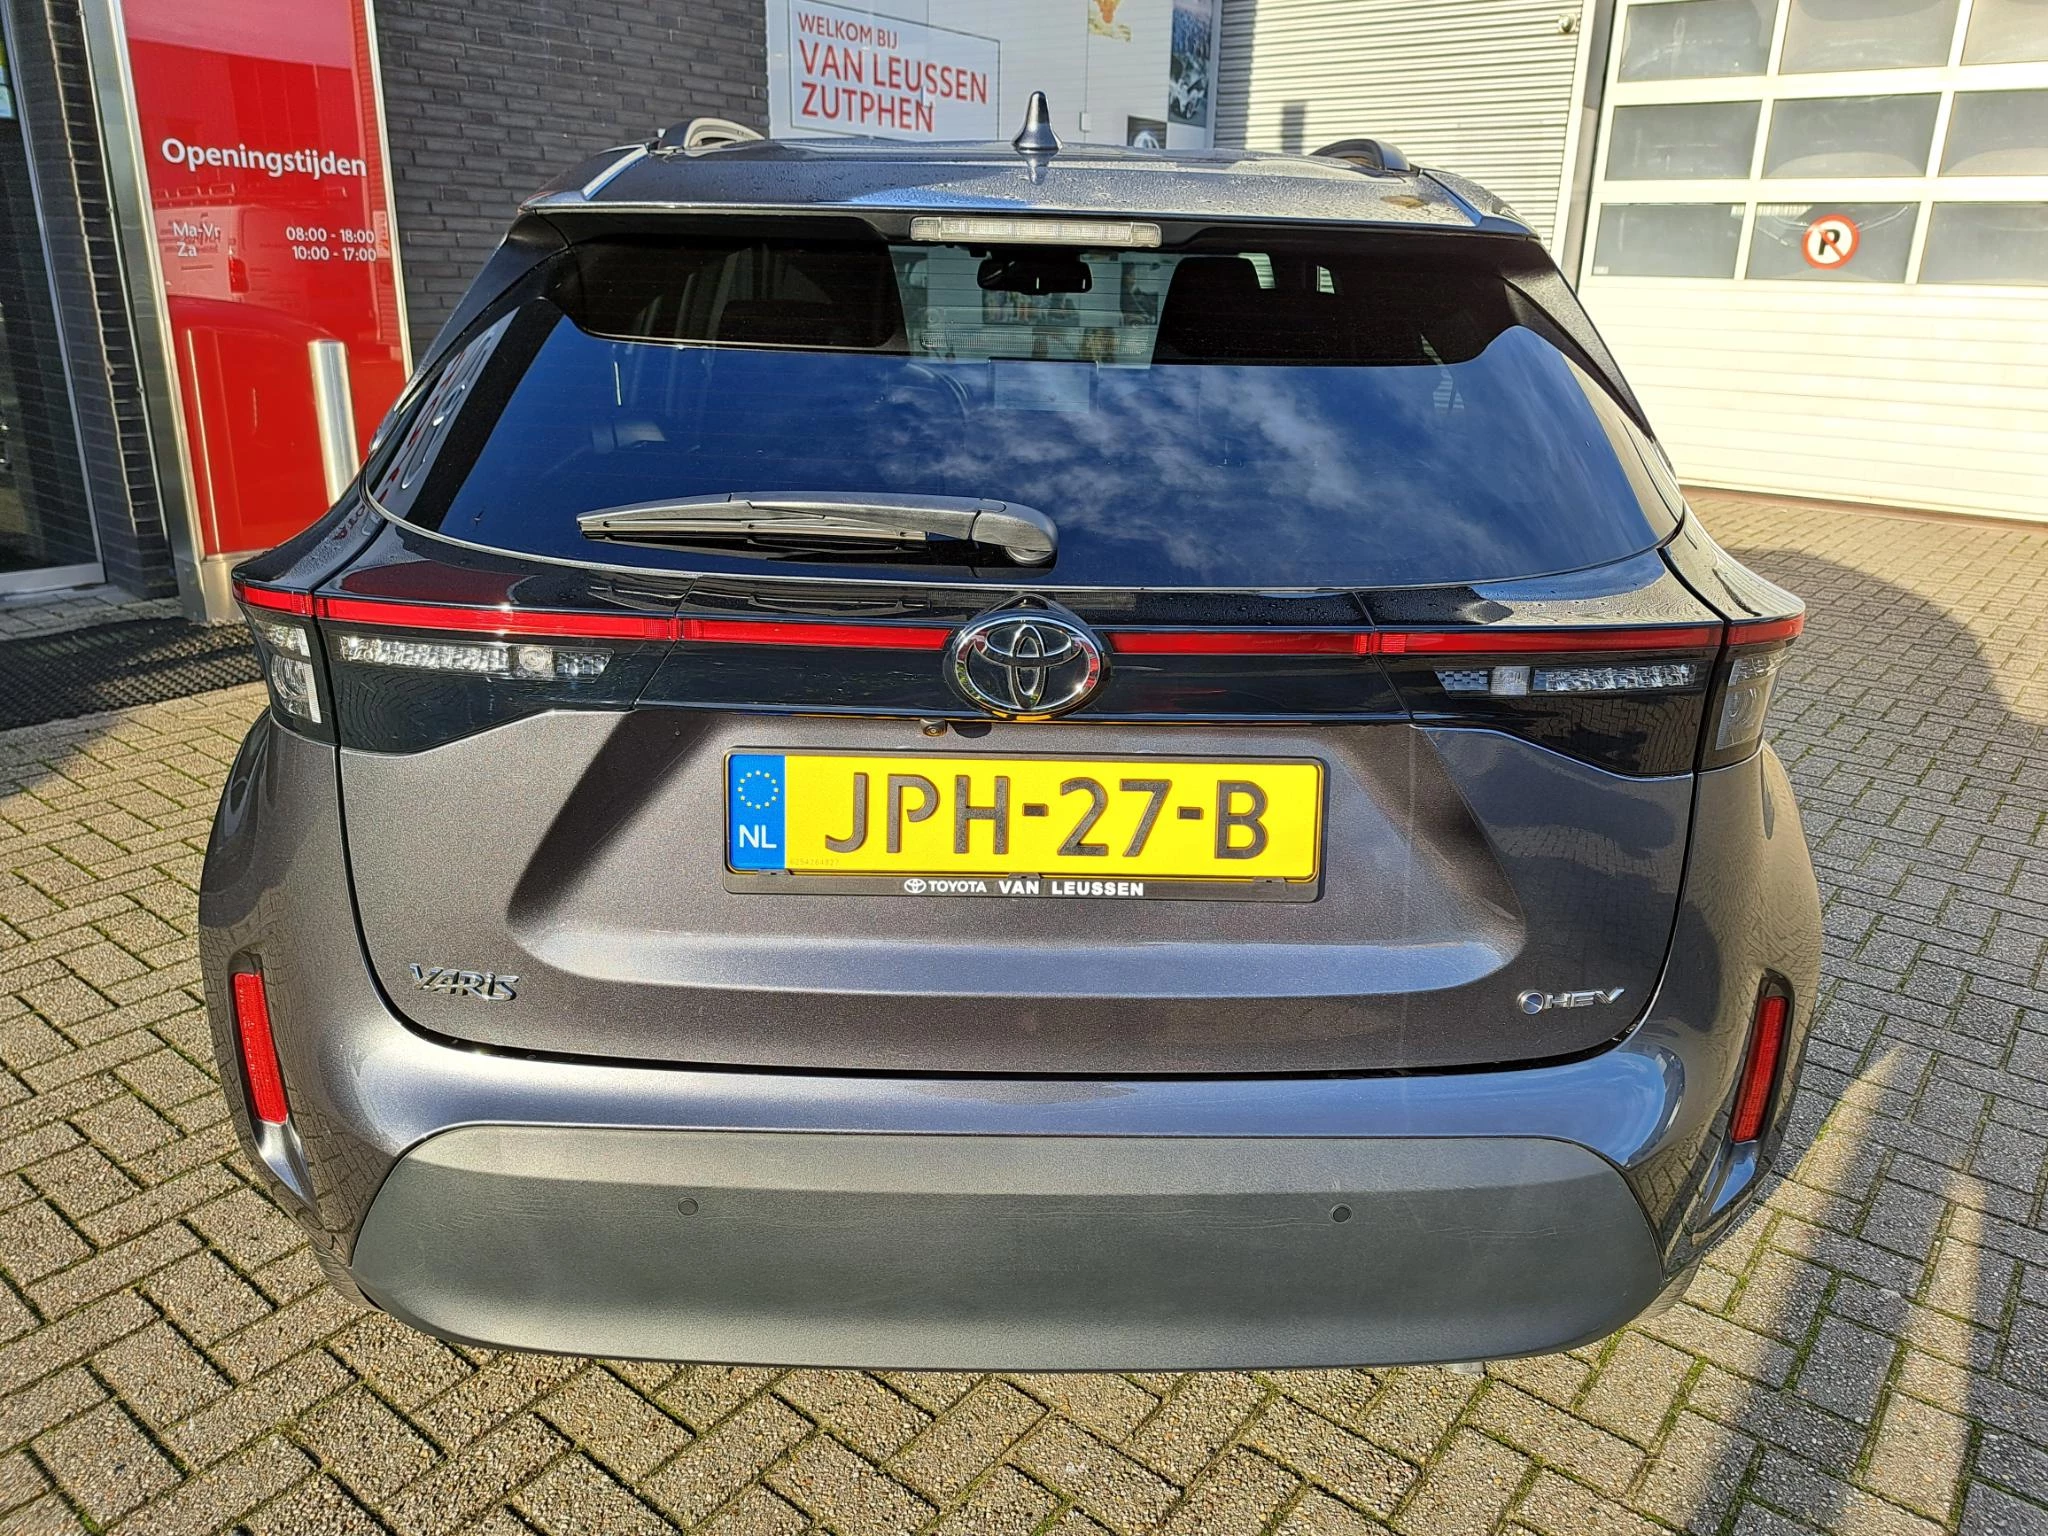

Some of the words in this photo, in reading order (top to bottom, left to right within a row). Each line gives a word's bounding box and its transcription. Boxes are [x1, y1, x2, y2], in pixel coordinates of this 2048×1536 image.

[798, 12, 873, 46] WELKOM
[877, 30, 898, 50] BIJ
[799, 39, 864, 84] VAN
[873, 53, 988, 105] LEUSSEN
[801, 81, 934, 133] ZUTPHEN
[161, 137, 368, 180] Openingstijden
[172, 221, 221, 238] Ma-Vr
[286, 226, 327, 242] 08:00
[339, 228, 375, 244] 18:00
[177, 241, 198, 257] Za
[292, 245, 330, 261] 10:00
[342, 246, 377, 262] 17:00
[825, 772, 1269, 860] JPH-27-B
[738, 824, 778, 849] NL
[928, 880, 988, 893] TOYOTA
[998, 880, 1040, 895] VAN
[1051, 881, 1144, 896] LEUSSEN
[1544, 987, 1625, 1010] HEV
